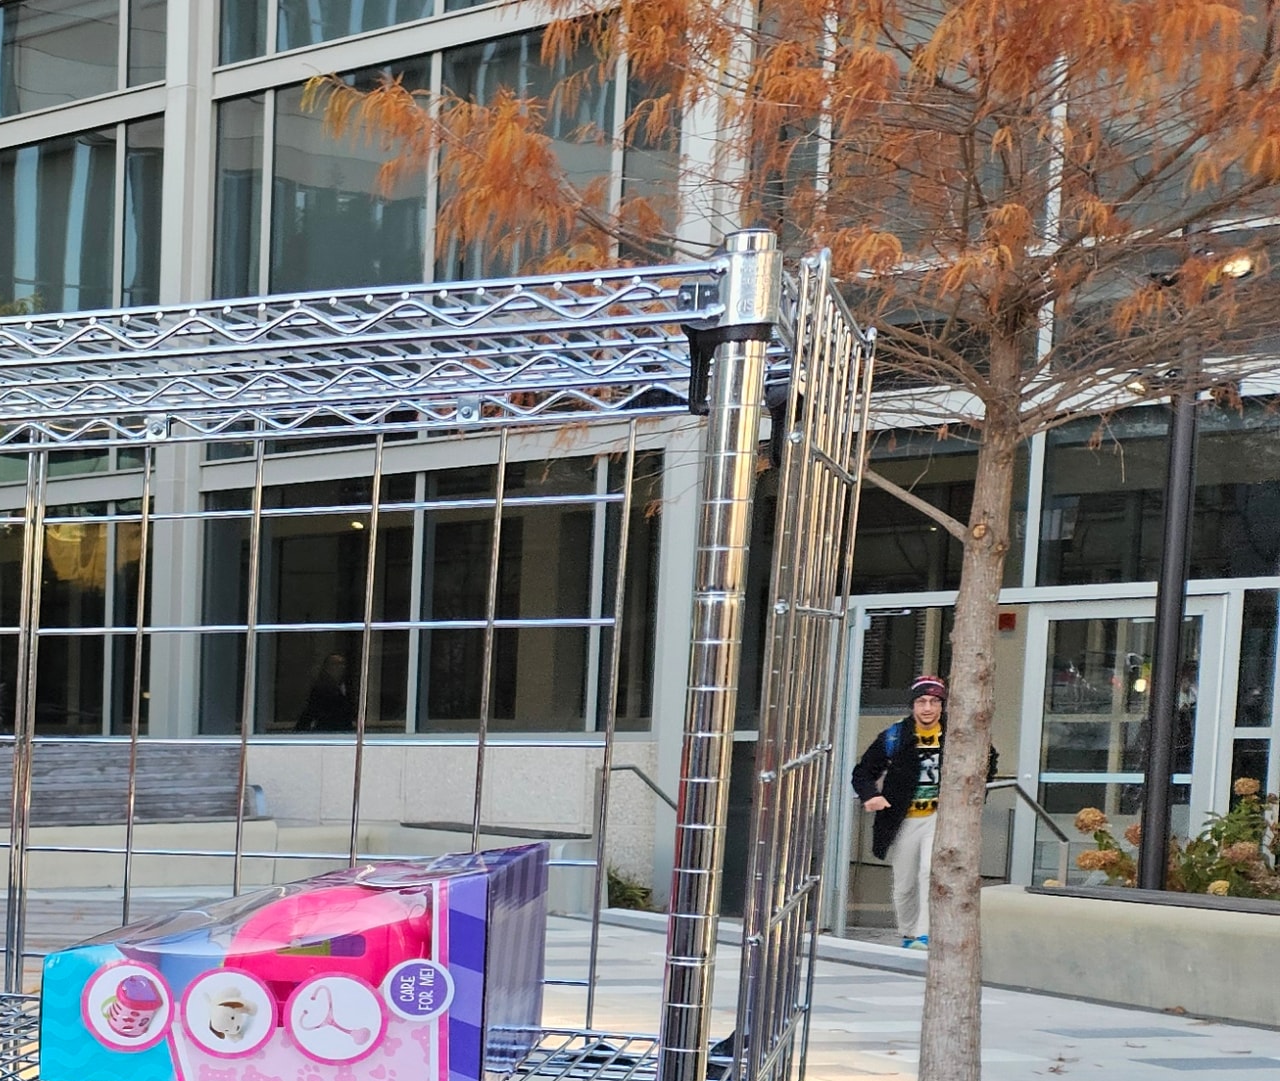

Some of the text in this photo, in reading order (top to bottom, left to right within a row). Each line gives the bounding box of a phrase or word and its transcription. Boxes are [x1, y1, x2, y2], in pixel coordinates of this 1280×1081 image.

[400, 975, 415, 1002] CARE
[418, 968, 434, 1011] FOR ME!
